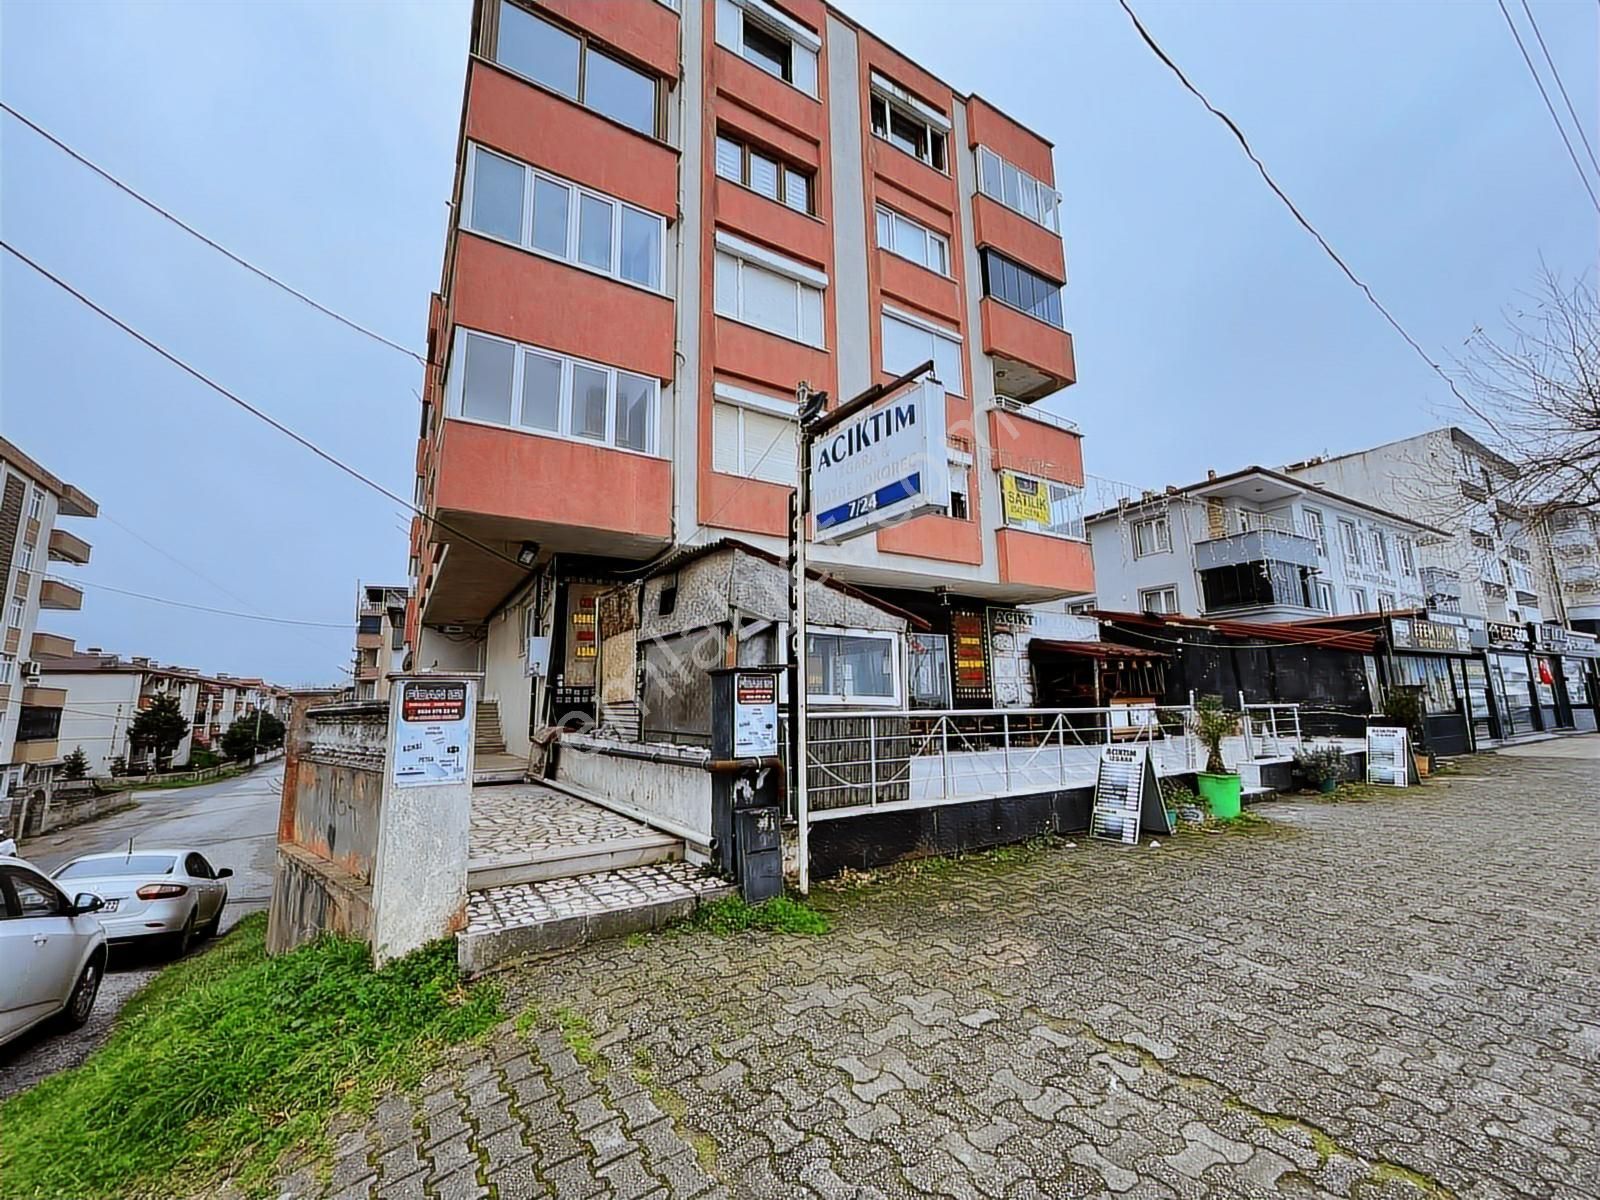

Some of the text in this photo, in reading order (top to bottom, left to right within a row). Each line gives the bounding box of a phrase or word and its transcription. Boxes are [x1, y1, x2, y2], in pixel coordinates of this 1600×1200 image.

[817, 403, 916, 473] ACIKTIM
[847, 493, 878, 518] 7/24
[1007, 490, 1047, 511] SATILIK
